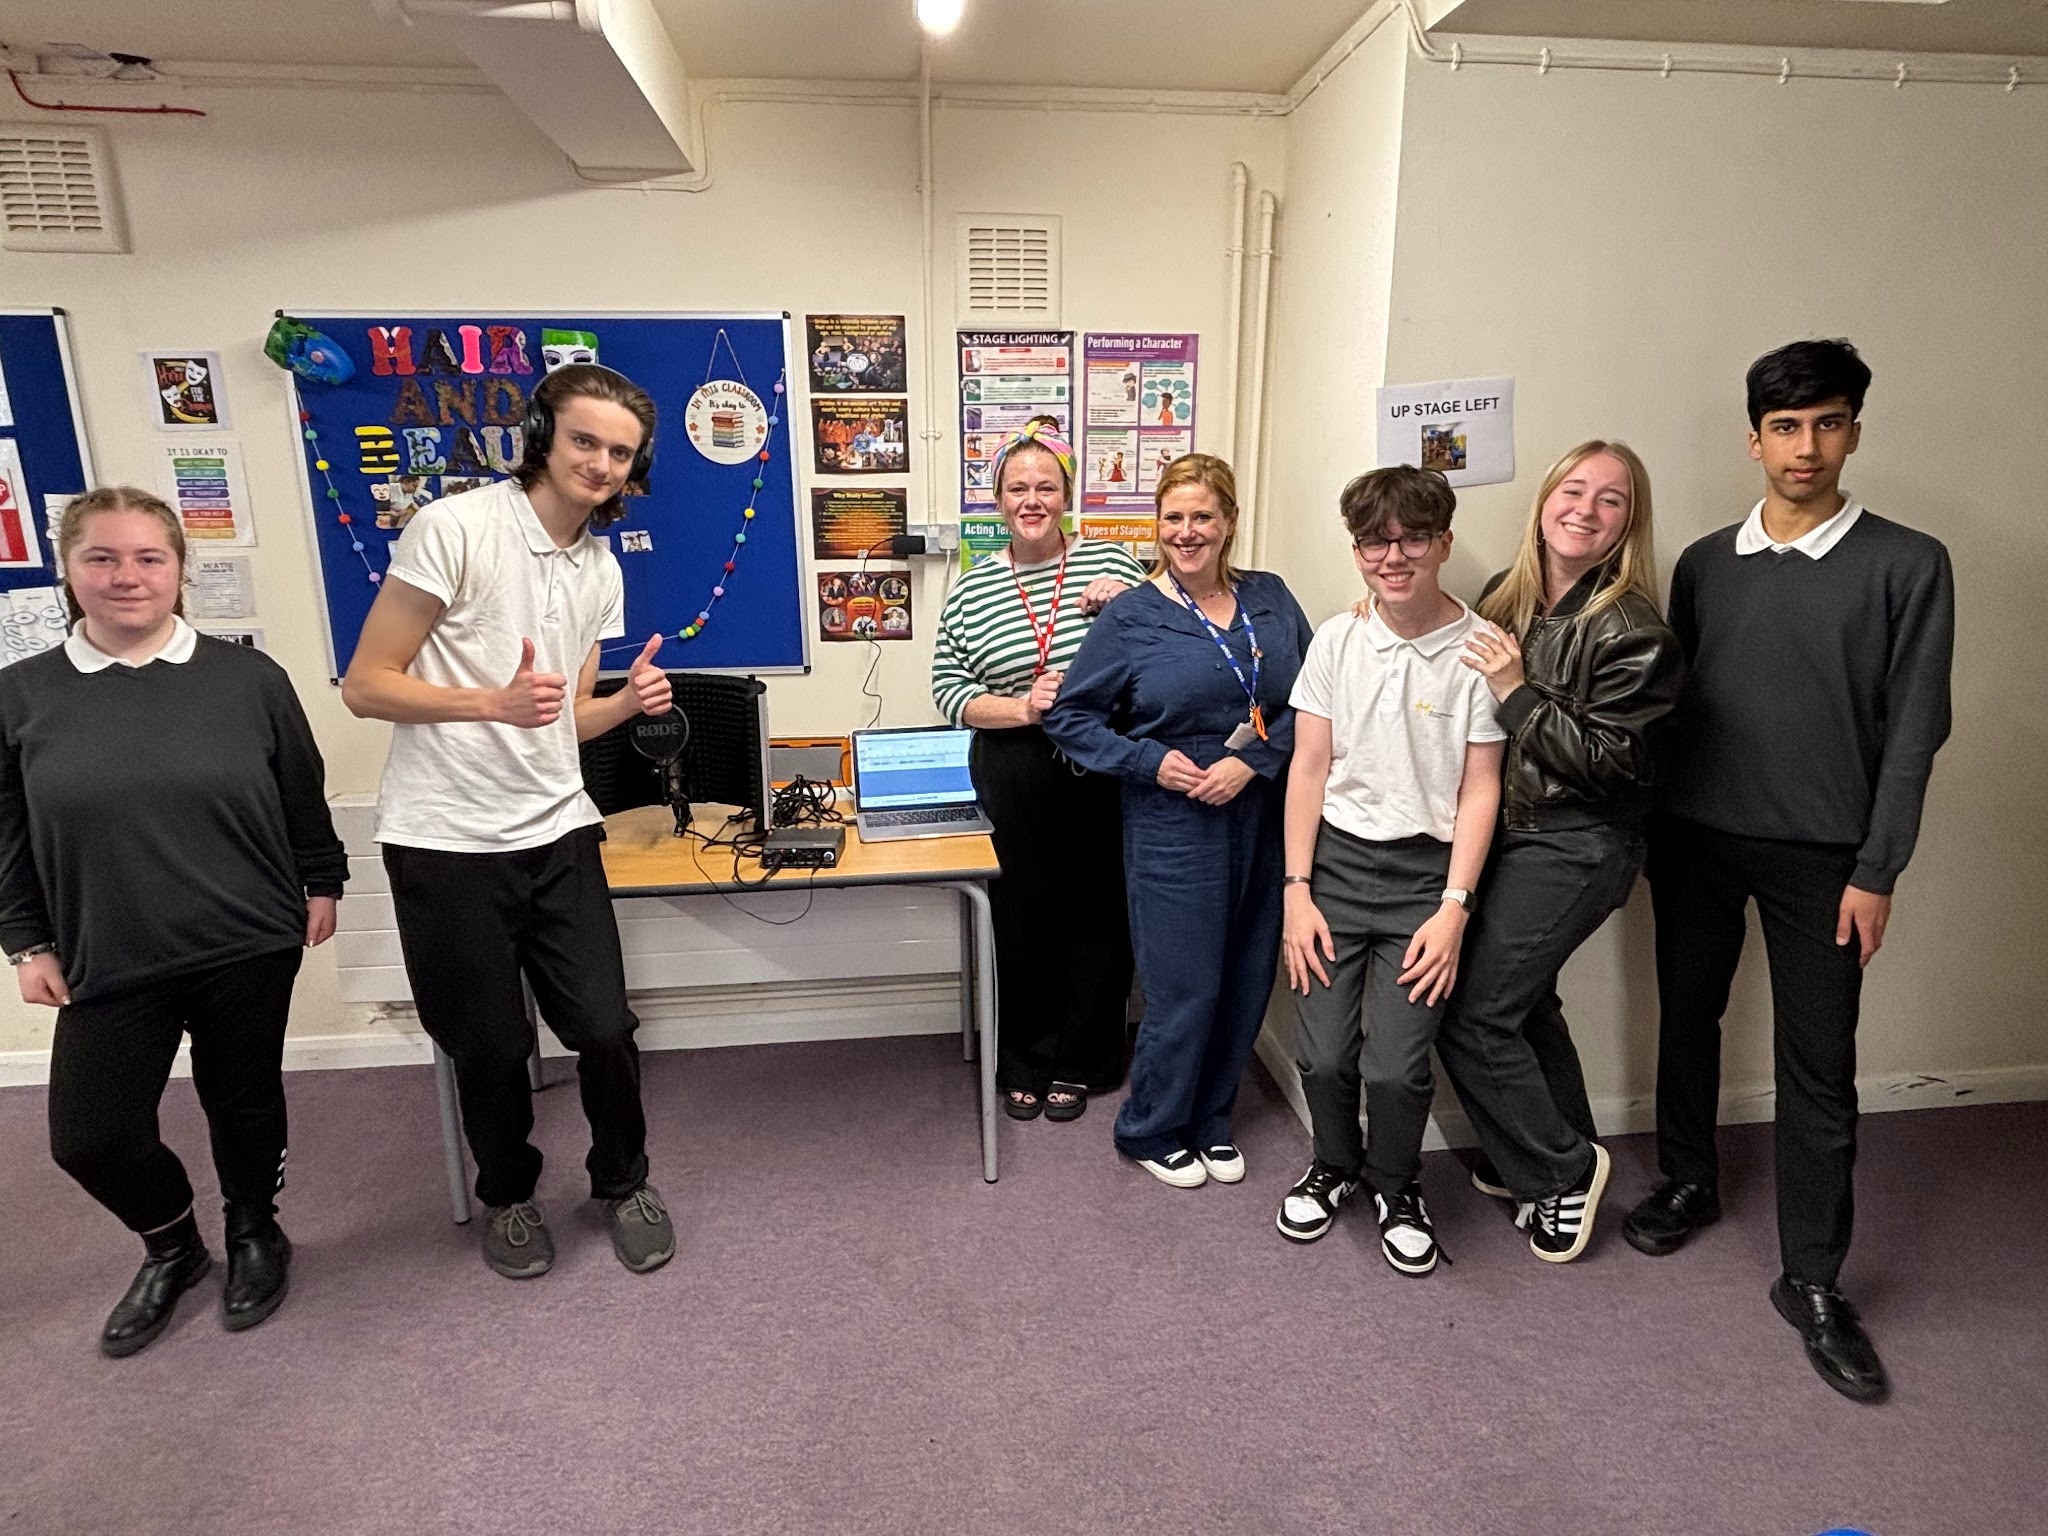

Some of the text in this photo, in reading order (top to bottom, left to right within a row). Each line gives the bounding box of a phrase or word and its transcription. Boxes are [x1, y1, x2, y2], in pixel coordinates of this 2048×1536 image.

[973, 334, 1058, 344] STAGE LIGHTING
[1087, 336, 1183, 351] Performing a Character
[368, 325, 534, 376] HAIR
[388, 376, 528, 425] AND
[721, 383, 762, 412] CLASSROOM
[1391, 397, 1500, 418] UP STAGE LEFT
[167, 448, 228, 456] IT IS OKAY TO
[354, 426, 524, 475] BEAU
[964, 522, 1012, 537] Acting Ter
[1084, 525, 1152, 538] Types of Staging
[636, 722, 681, 737] RØDE
